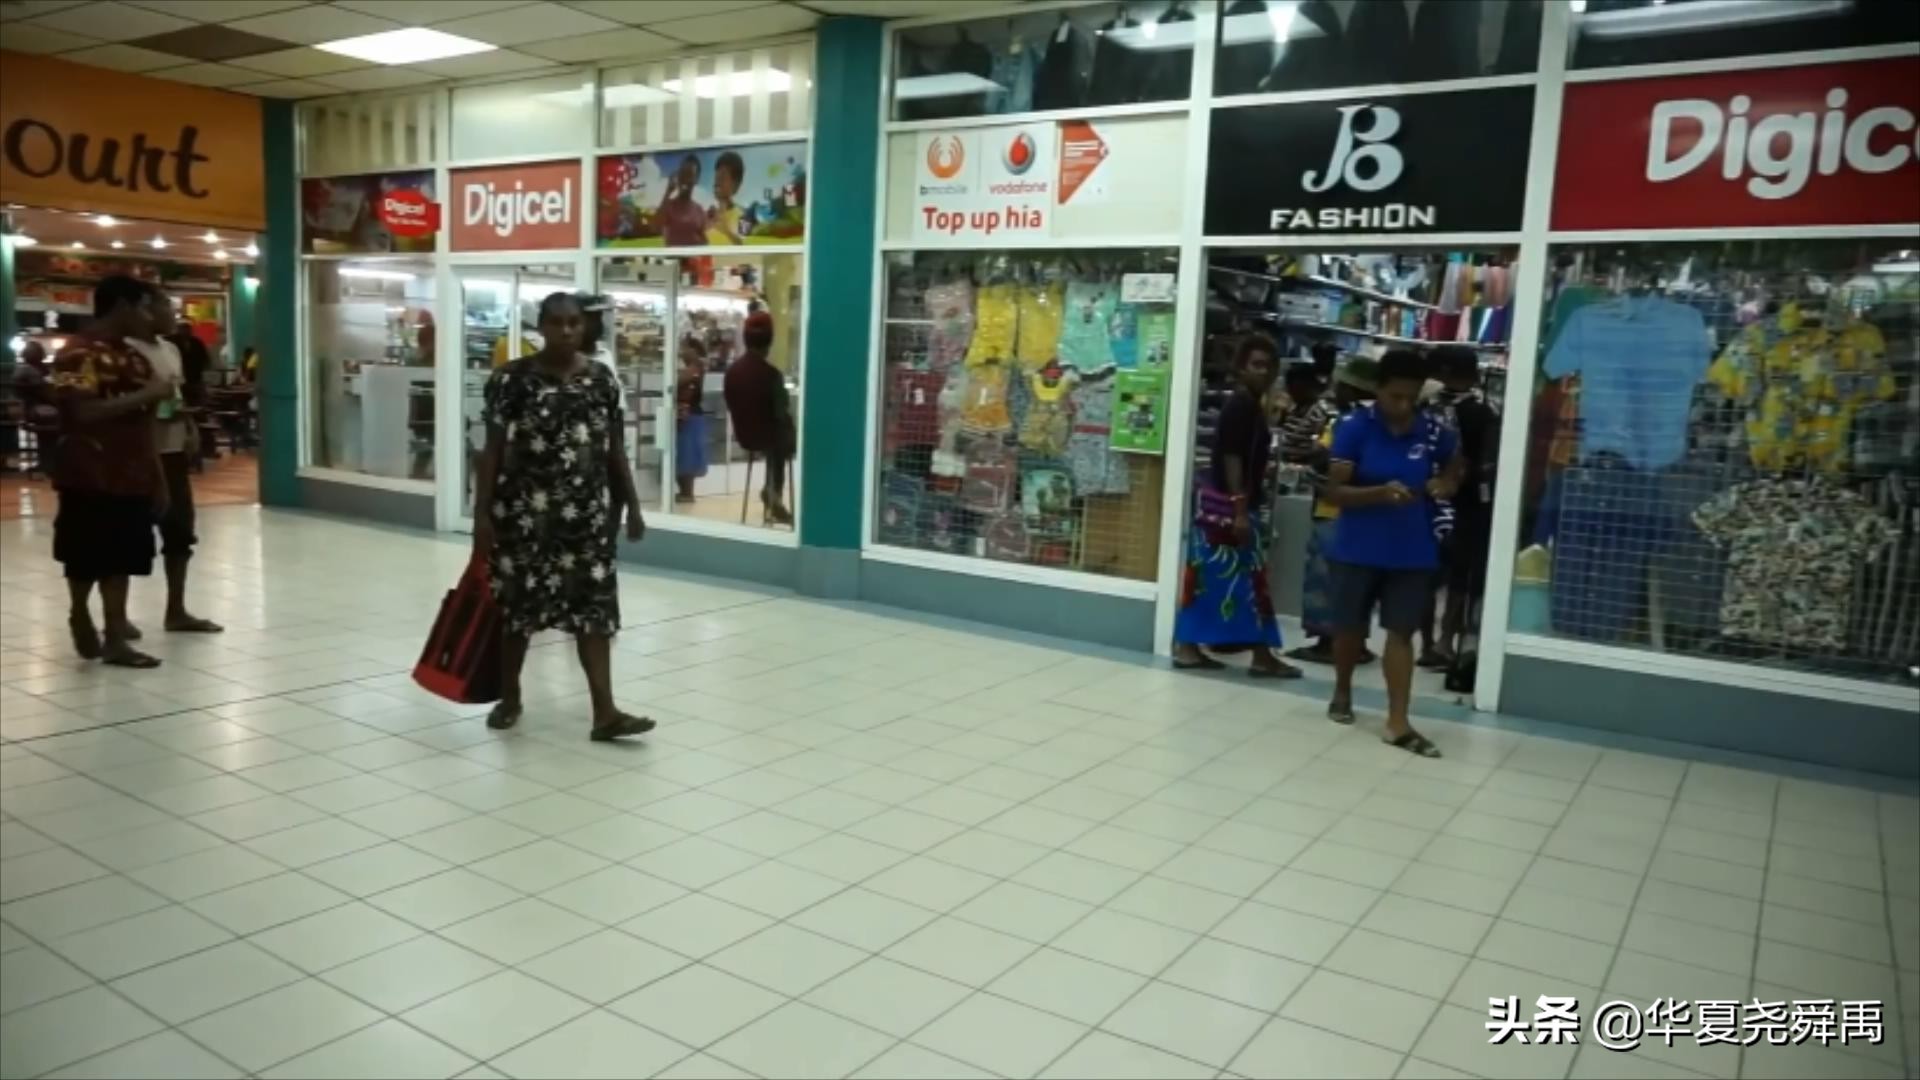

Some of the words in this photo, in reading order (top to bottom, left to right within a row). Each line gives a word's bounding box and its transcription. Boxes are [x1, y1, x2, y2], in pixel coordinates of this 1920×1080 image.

[1645, 87, 1920, 200] Digic
[989, 181, 1048, 195] vodafone
[463, 177, 571, 237] Digicel
[922, 206, 965, 234] Top
[971, 212, 1000, 234] up
[1006, 204, 1042, 229] hia
[1269, 203, 1436, 230] FASHION
